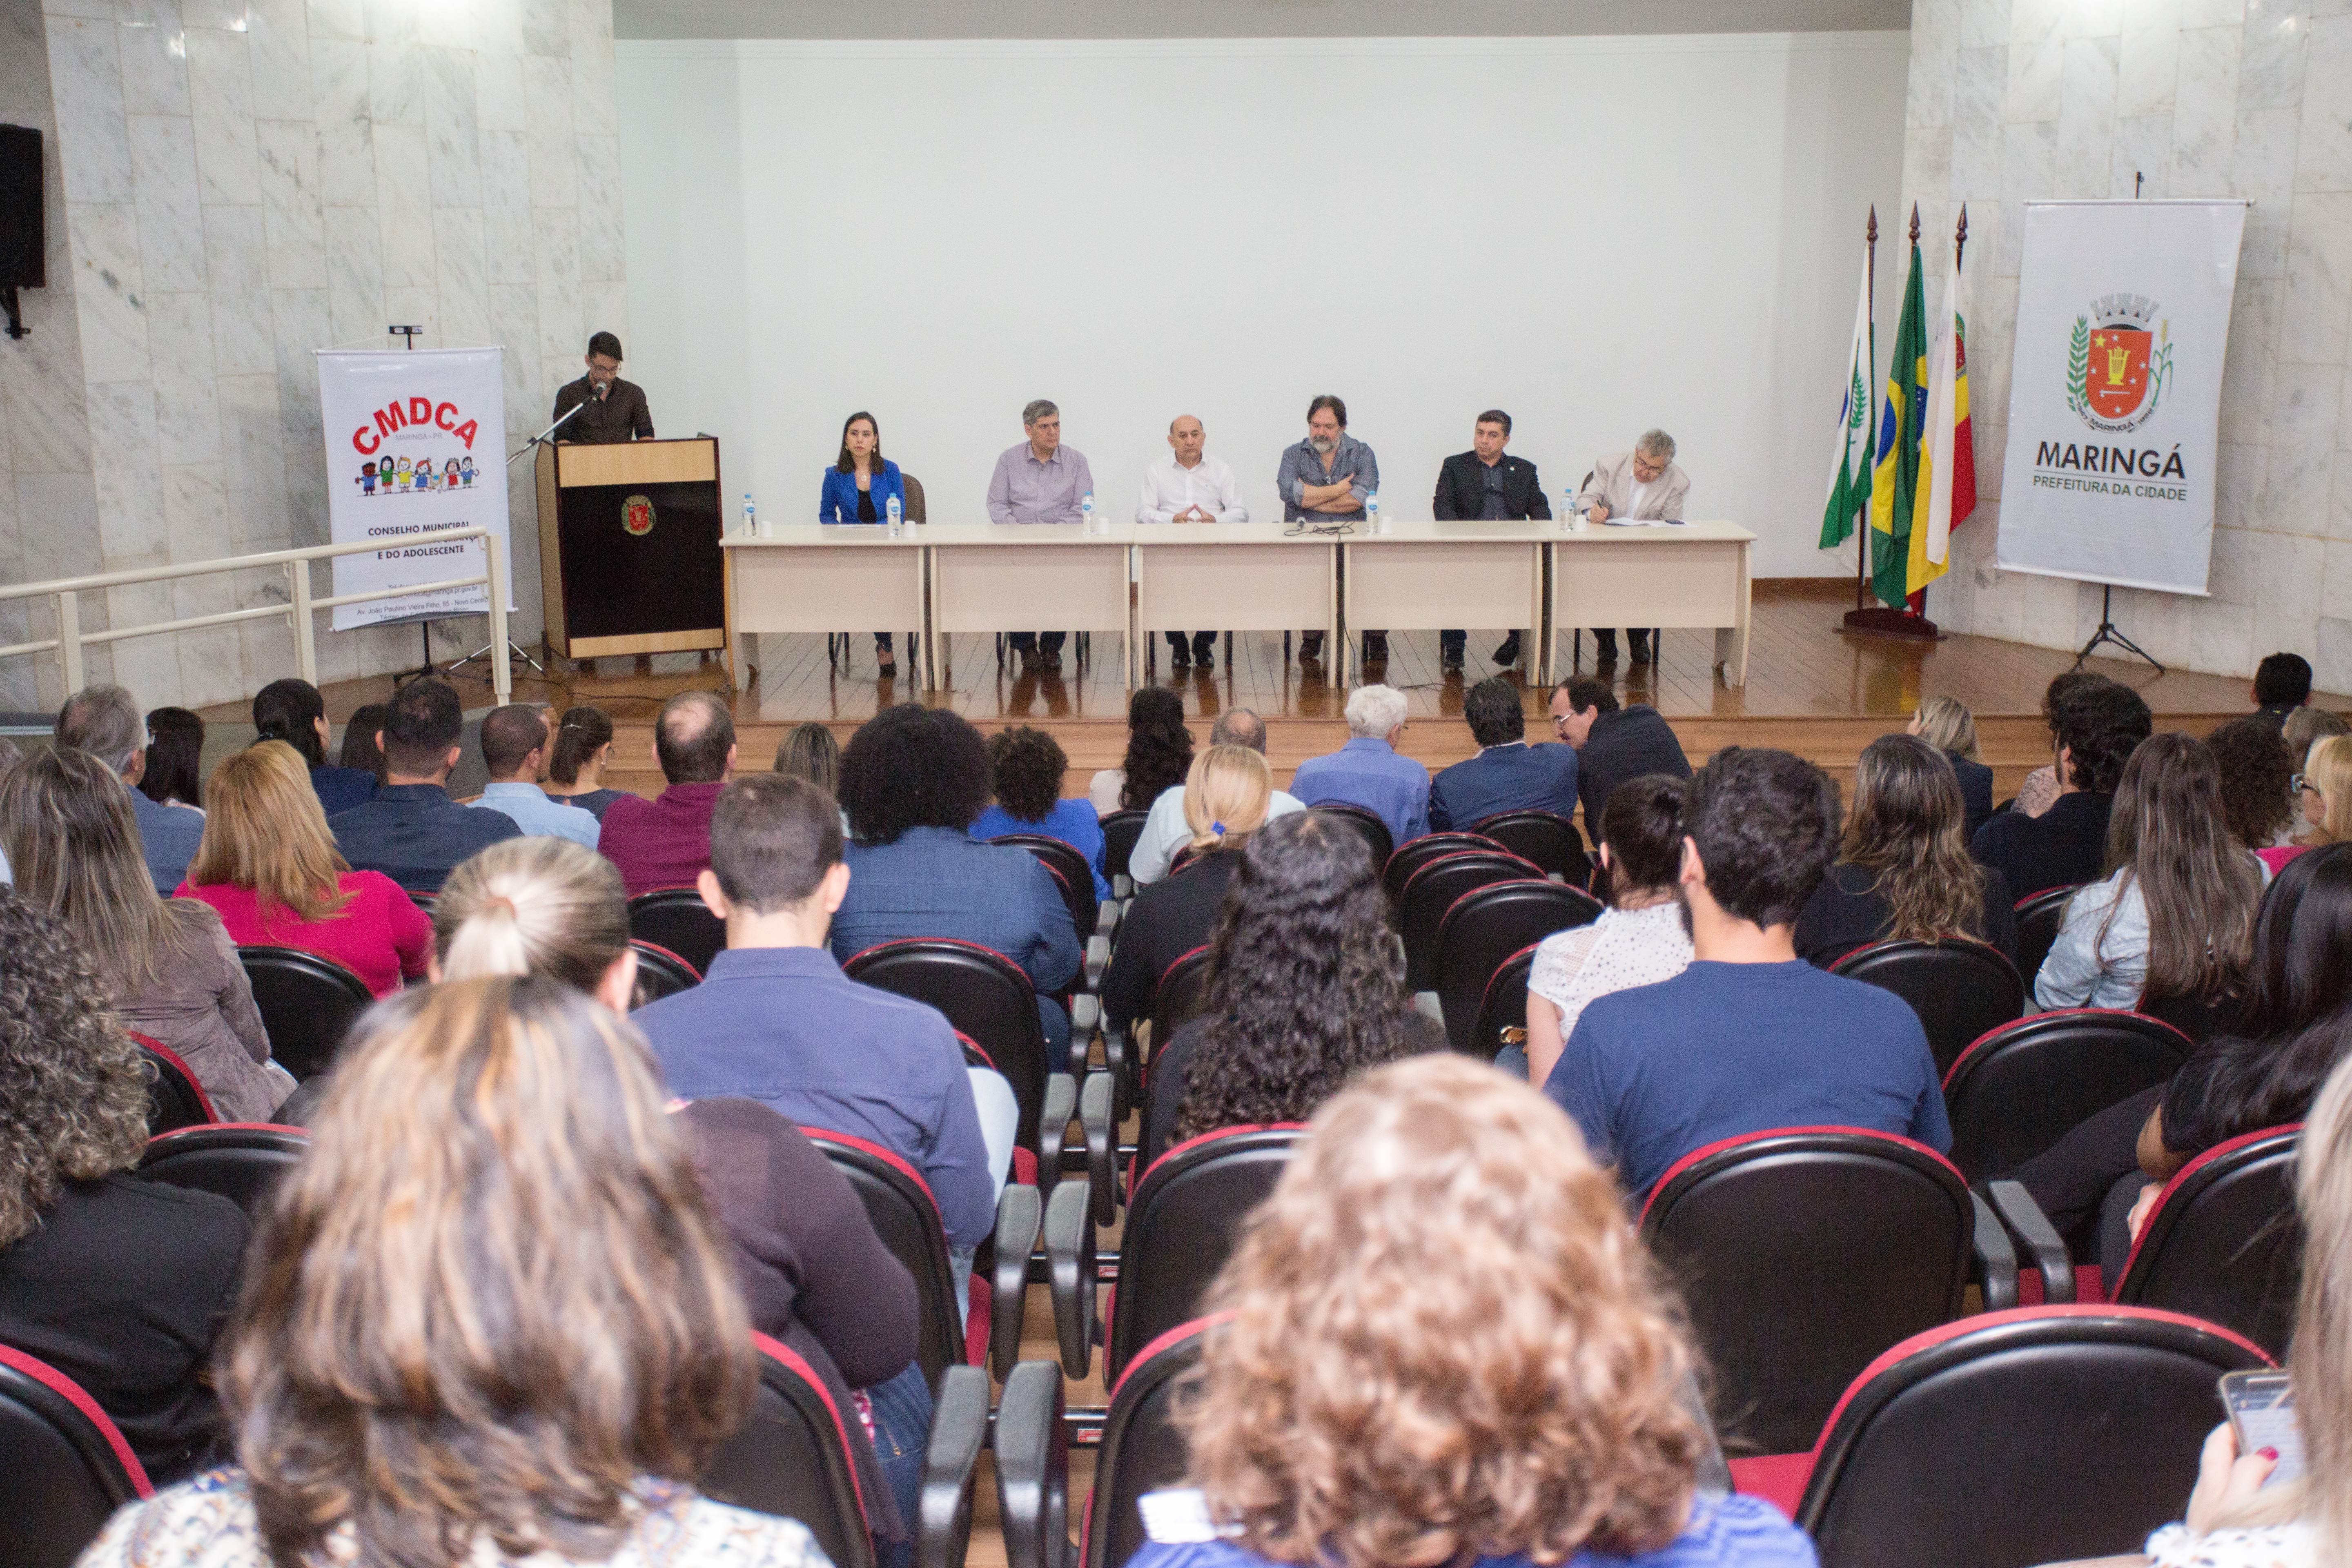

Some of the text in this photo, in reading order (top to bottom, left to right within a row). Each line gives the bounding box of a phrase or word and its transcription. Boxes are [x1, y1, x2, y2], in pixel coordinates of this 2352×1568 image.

[353, 396, 478, 455] CMDCA
[2036, 441, 2186, 479] MARINGÁ
[2033, 475, 2187, 501] PREFEITURA DA CIDADE
[368, 525, 419, 536] CONSELHO
[403, 545, 464, 557] ADOLESCENTE
